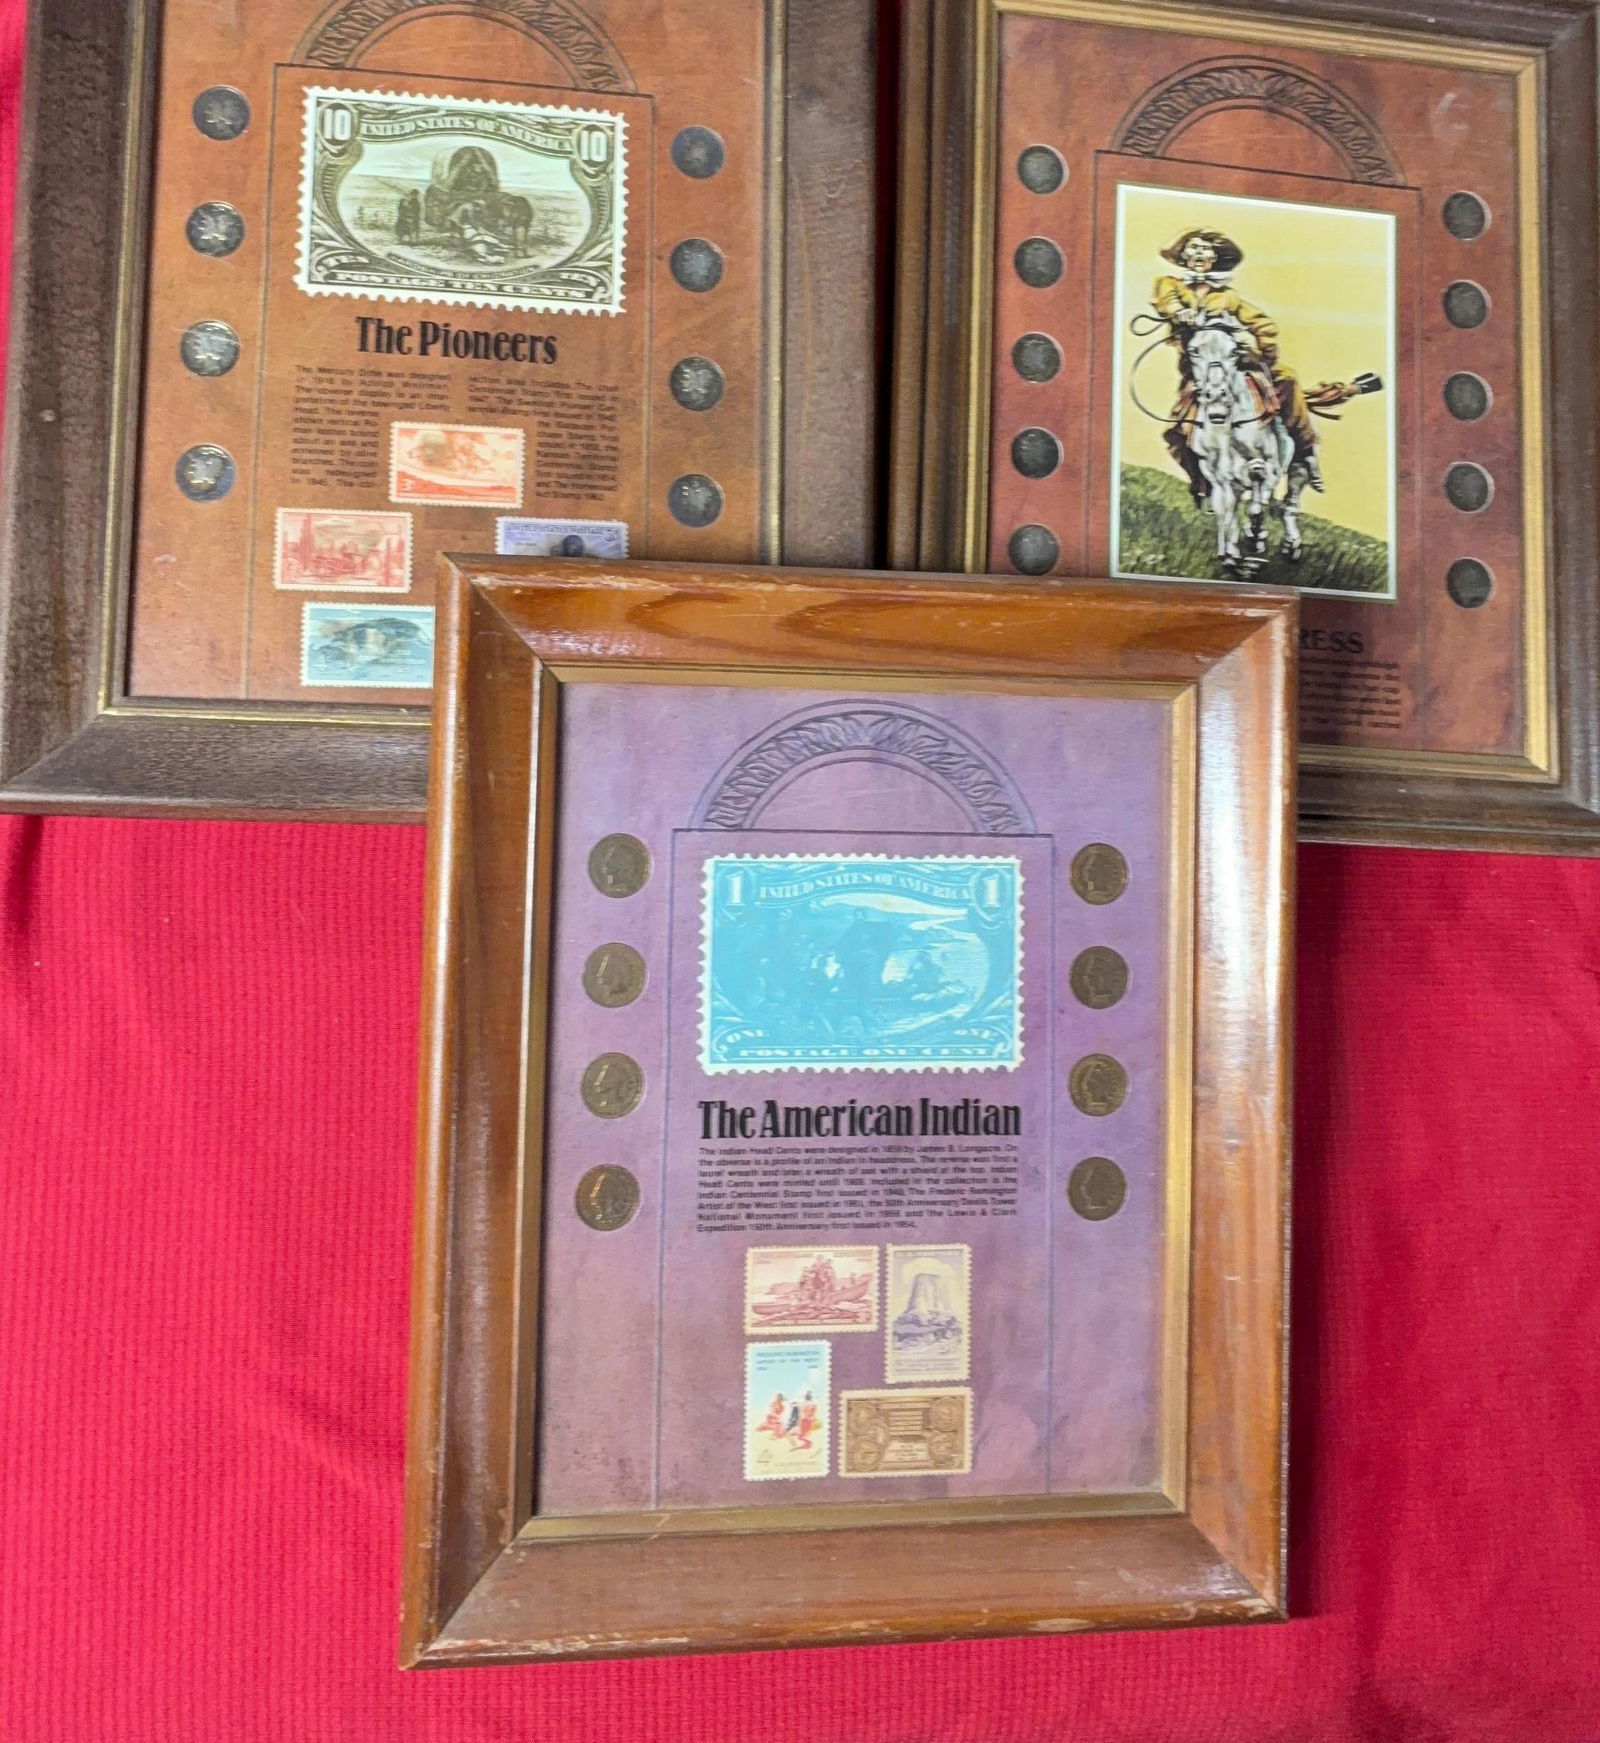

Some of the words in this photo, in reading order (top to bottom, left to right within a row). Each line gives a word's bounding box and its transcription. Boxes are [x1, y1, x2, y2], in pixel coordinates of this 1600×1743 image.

[324, 108, 351, 140] 10
[361, 119, 414, 135] UNITED
[415, 116, 474, 130] STATES
[477, 119, 499, 131] OF
[500, 123, 573, 150] AMERICA
[578, 129, 605, 161] 10
[336, 273, 443, 288] POSTAGE
[449, 279, 499, 292] TEN
[503, 284, 587, 299] CENTS
[355, 316, 414, 355] The
[419, 320, 559, 364] Pioneers
[725, 870, 745, 907] 1
[759, 881, 814, 899] UNITED
[815, 874, 873, 890] STATES
[875, 873, 896, 886] OF
[899, 876, 972, 900] AMERICA
[983, 876, 1002, 908] 1
[740, 1048, 851, 1058] POSTAGE
[862, 1047, 915, 1057] ONE
[698, 1099, 756, 1139] The
[759, 1098, 914, 1138] American
[920, 1097, 1022, 1136] Indian
